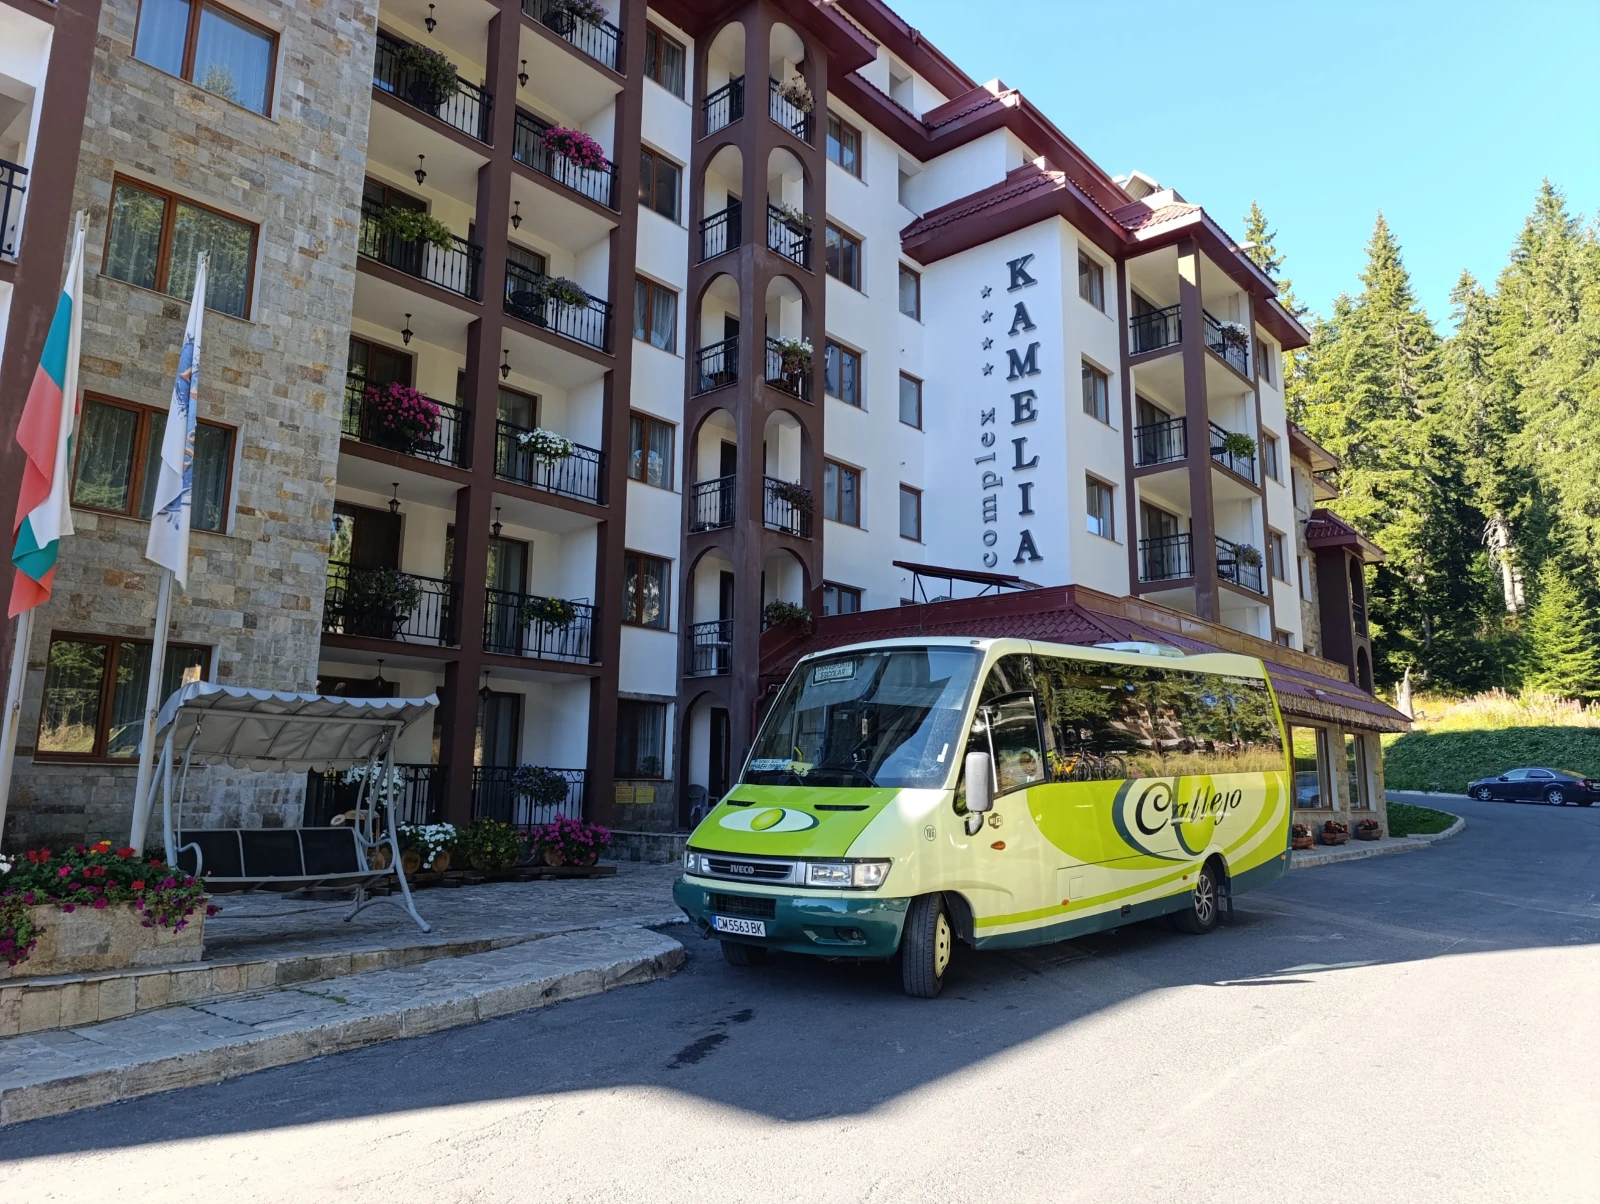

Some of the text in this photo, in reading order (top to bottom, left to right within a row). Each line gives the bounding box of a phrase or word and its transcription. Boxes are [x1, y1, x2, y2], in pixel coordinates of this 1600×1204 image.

[1005, 253, 1043, 564] KAMELIA
[974, 406, 1003, 568] complex
[1135, 782, 1242, 836] Callejo
[730, 864, 755, 874] IVECO
